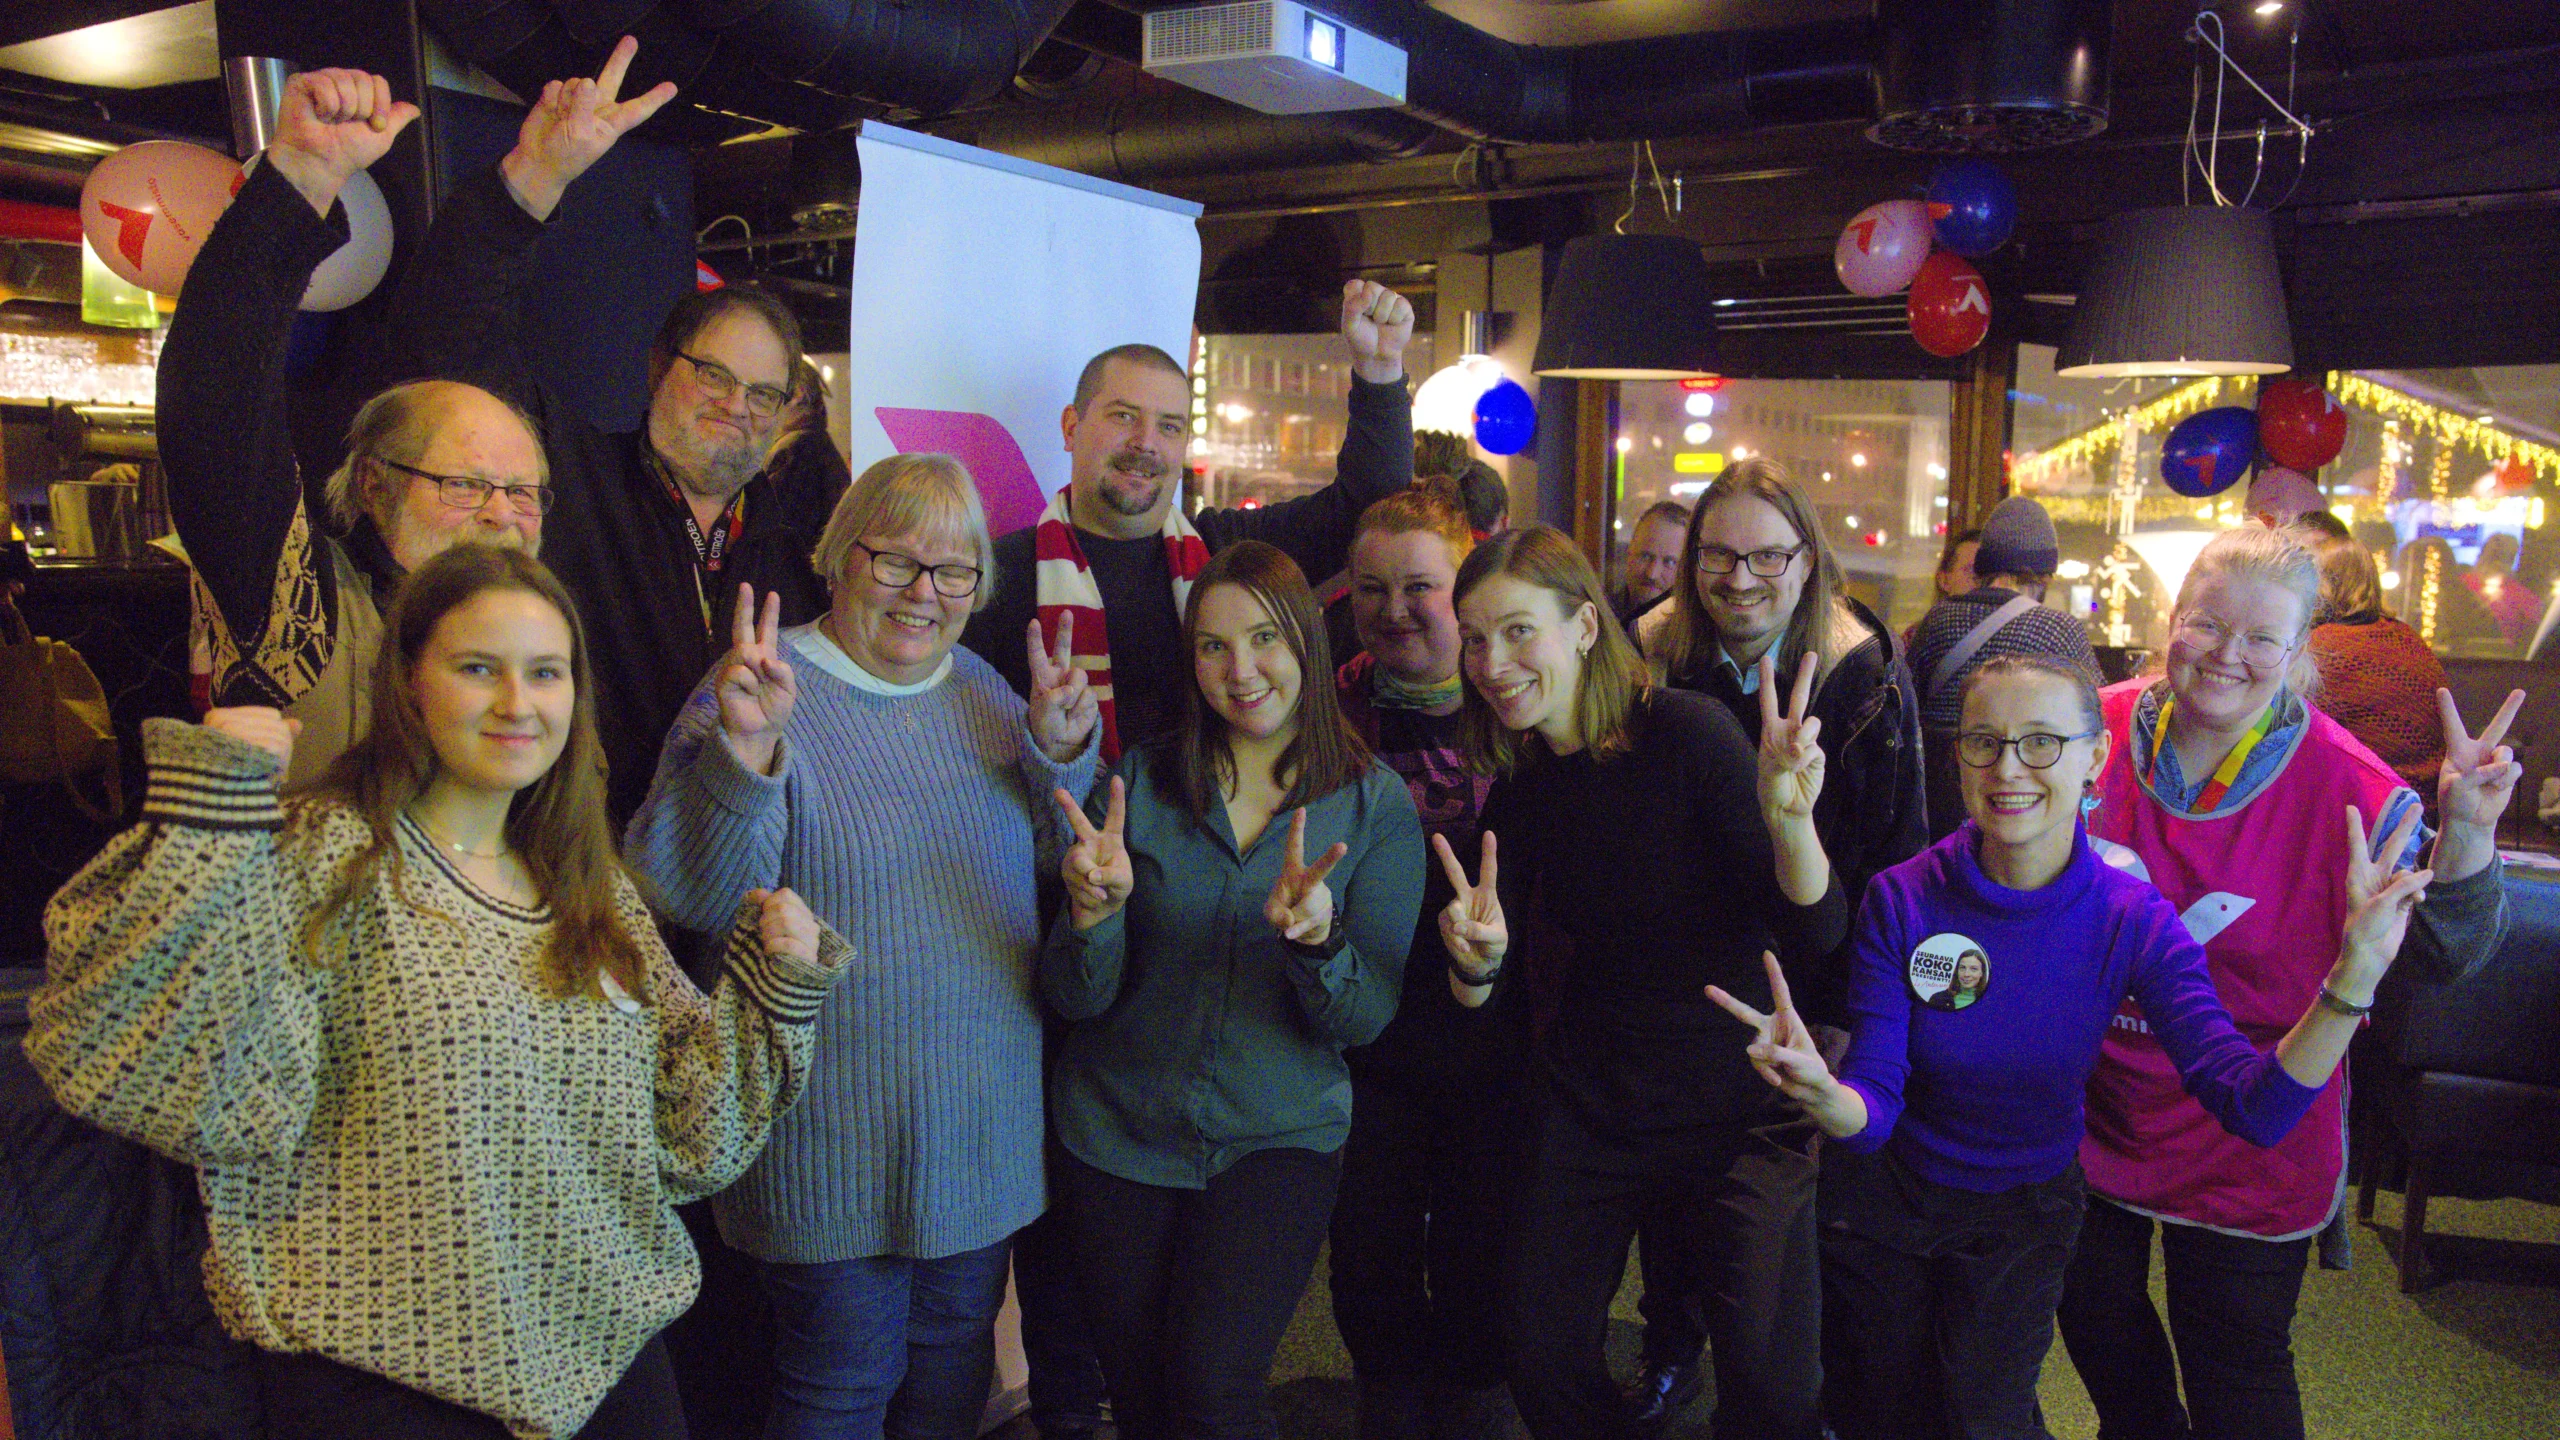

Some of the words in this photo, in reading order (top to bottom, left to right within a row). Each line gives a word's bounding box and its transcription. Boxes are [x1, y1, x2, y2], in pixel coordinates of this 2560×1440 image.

[1916, 950, 1954, 963] SEURAAVA
[1914, 956, 1953, 972] KOKO
[1911, 972, 1951, 983] PRESIDENTTI
[1912, 966, 1952, 980] KANSAN
